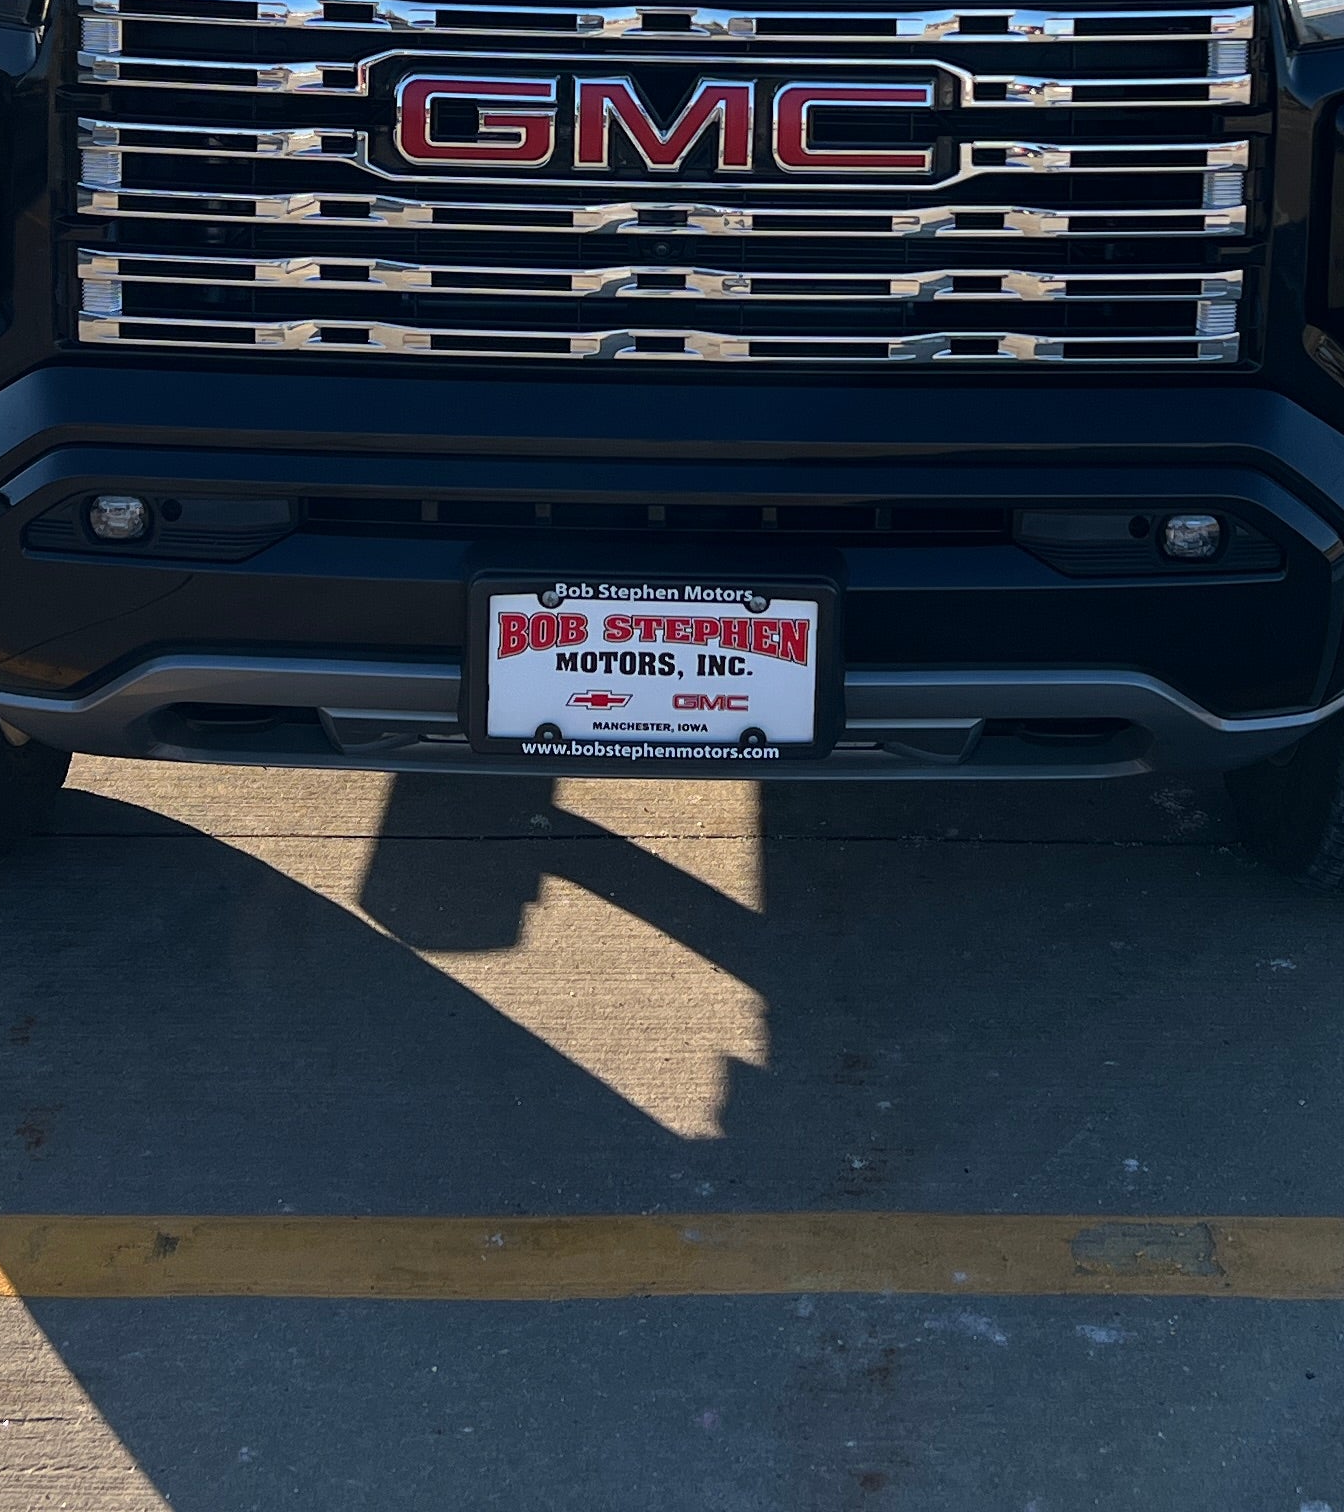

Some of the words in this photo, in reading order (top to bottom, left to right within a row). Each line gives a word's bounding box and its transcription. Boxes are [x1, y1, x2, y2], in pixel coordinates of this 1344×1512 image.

[394, 73, 936, 175] GMC
[555, 583, 593, 598] Bob
[598, 584, 679, 602] Stephen
[684, 586, 753, 602] Motors
[497, 611, 588, 659] BOB
[604, 614, 810, 667] STEPHEN
[555, 651, 683, 680] MOTORS,
[696, 653, 753, 676] INC.
[672, 693, 749, 711] GMC
[592, 721, 674, 733] MANCHESTER,
[677, 723, 708, 733] IOWA
[521, 740, 779, 760] www.bobstephenmotors.com
